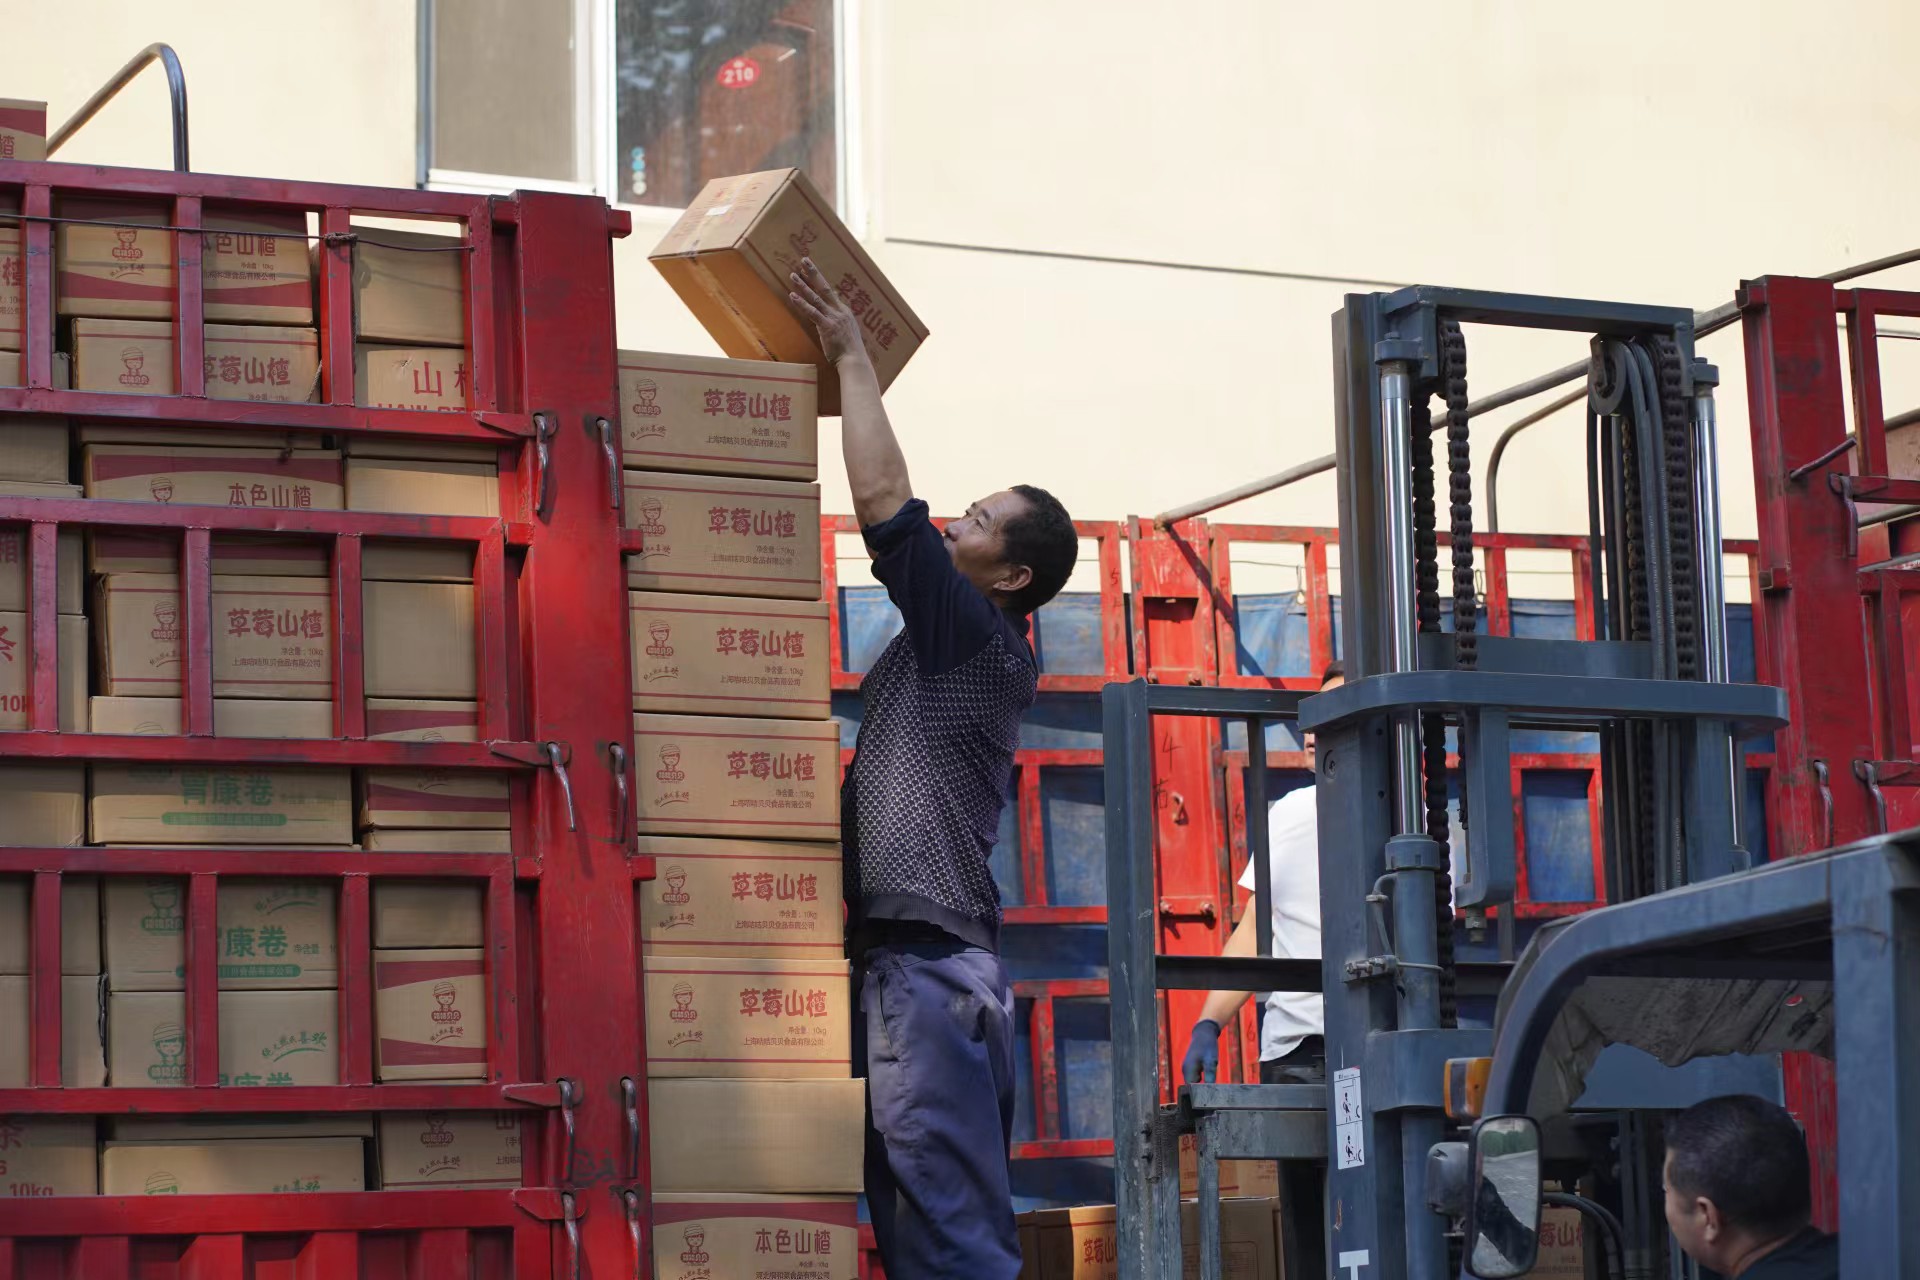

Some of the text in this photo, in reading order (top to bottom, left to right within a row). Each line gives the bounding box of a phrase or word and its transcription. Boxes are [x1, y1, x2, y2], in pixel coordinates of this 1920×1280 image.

[724, 67, 754, 84] 210
[836, 272, 899, 351] 草莓山楂
[703, 388, 792, 421] 草莓山楂
[228, 483, 311, 508] 本色山楂
[708, 506, 797, 538] 草莓山楂
[228, 608, 324, 639] 草莓山楂
[716, 627, 805, 659] 草莓山楂
[727, 750, 816, 781] 草莓山楂
[731, 871, 818, 902] 草莓山楂
[219, 925, 288, 958] 康卷
[739, 988, 828, 1019] 草莓山楂
[755, 1228, 832, 1255] 本色山楂
[1083, 1237, 1117, 1265] 草莓山
